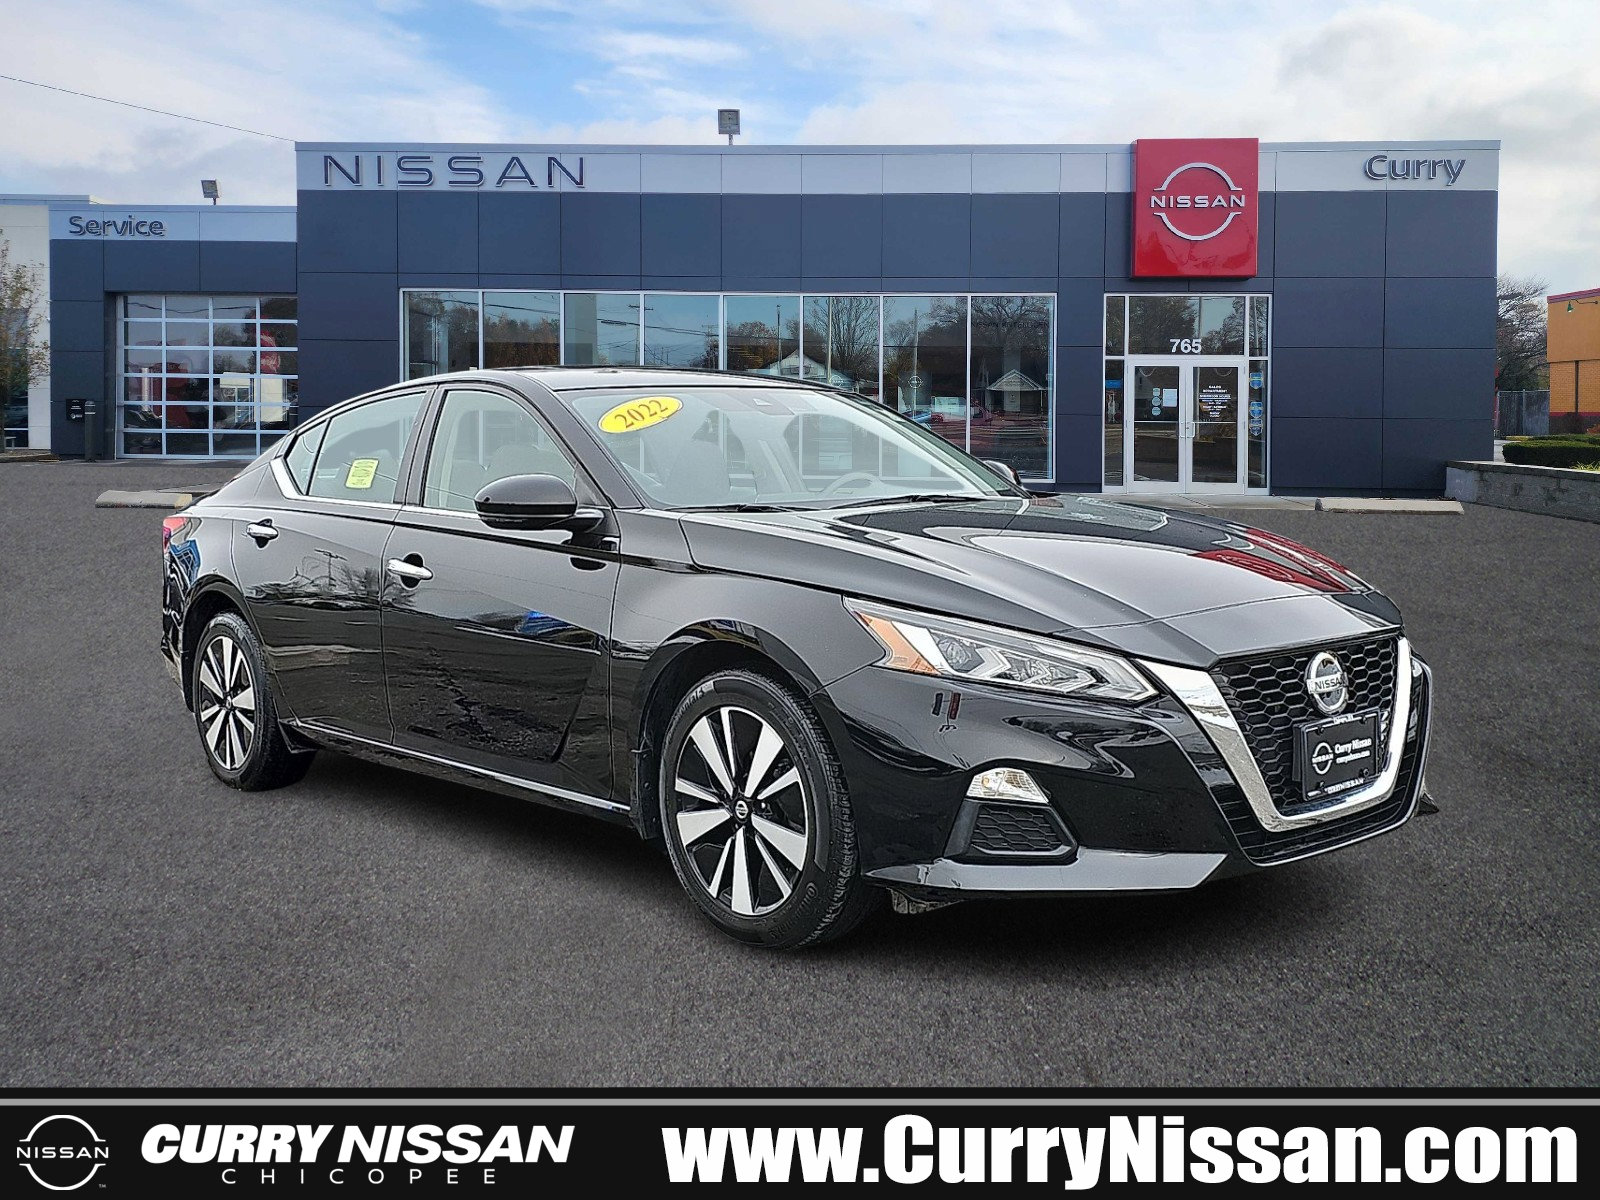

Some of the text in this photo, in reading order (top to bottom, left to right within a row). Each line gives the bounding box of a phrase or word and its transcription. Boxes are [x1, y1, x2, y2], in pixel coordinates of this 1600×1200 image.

[323, 155, 585, 188] NISSAN
[1364, 154, 1466, 186] Curry
[1150, 194, 1246, 208] NISSAN
[68, 214, 166, 236] Service
[1169, 338, 1202, 354] 765
[614, 399, 669, 429] 2022
